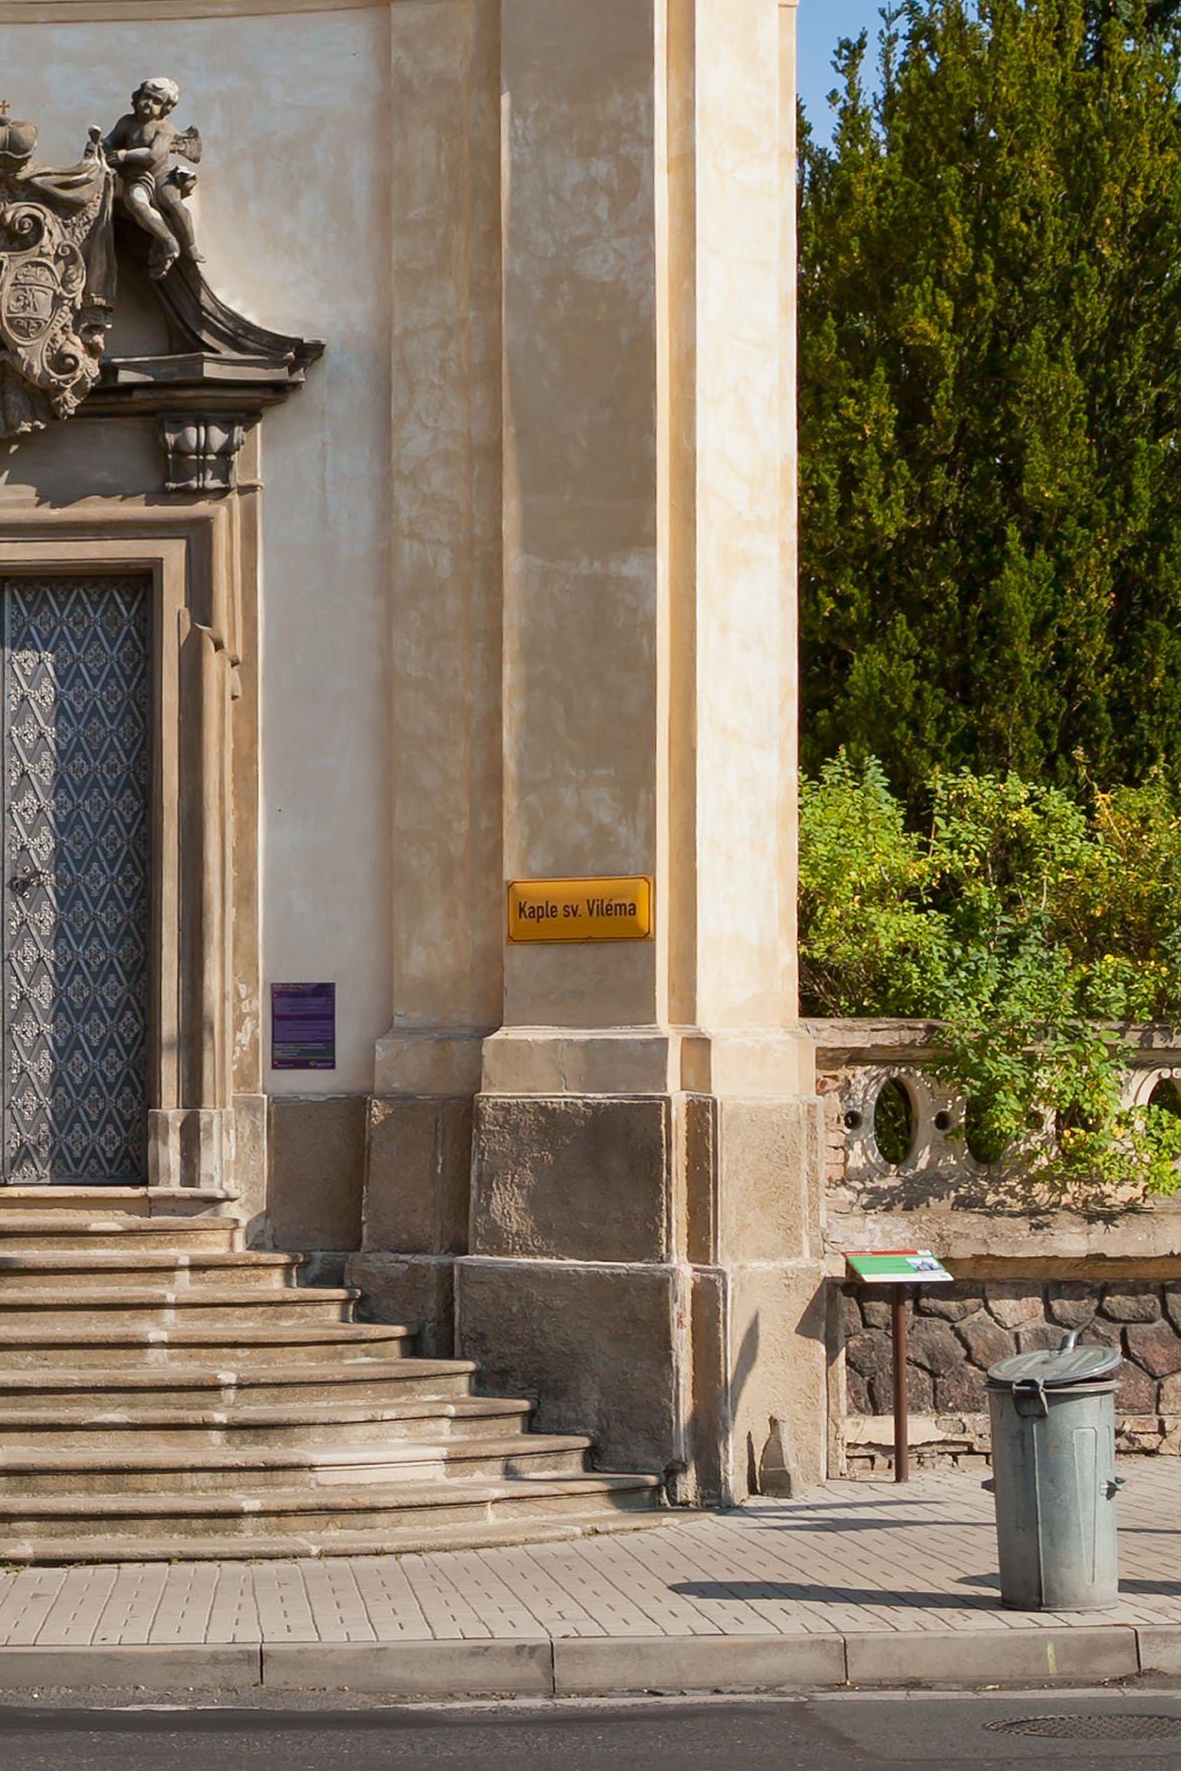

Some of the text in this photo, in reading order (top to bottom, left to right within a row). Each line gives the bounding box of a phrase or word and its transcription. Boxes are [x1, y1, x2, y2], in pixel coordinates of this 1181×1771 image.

[518, 899, 636, 923] Kaple sv. Viléma
